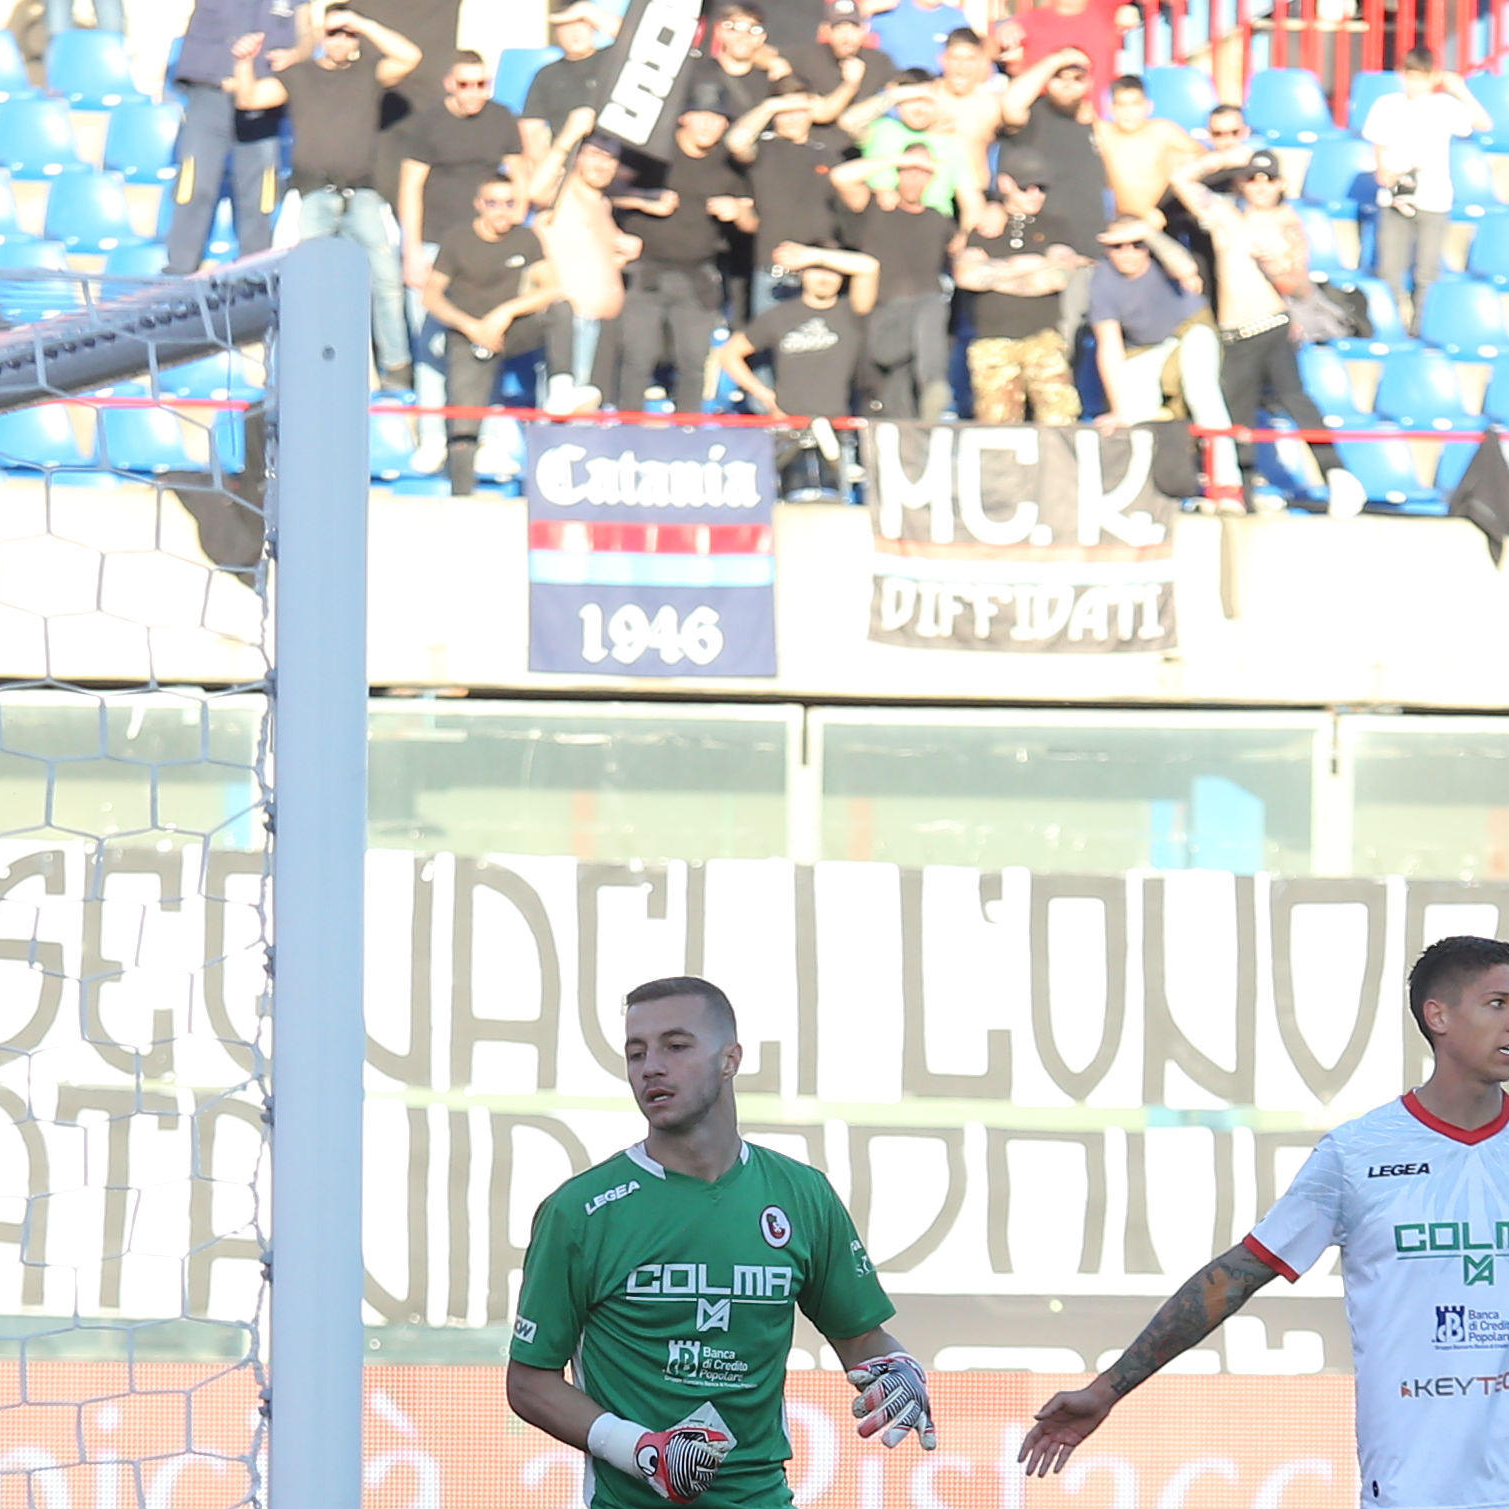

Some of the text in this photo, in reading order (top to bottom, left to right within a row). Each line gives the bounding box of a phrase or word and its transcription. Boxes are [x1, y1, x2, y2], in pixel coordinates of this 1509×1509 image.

[535, 444, 761, 508] Catania
[879, 577, 1164, 642] DIFFIDATI
[579, 602, 723, 664] 1946
[1367, 1162, 1431, 1179] LEGEA
[584, 1179, 641, 1215] LEGEA
[625, 1263, 792, 1298] COLMA
[1468, 1309, 1500, 1320] Banca
[1468, 1320, 1478, 1331] di
[702, 1346, 736, 1360] Banca
[702, 1359, 748, 1372] di Credito
